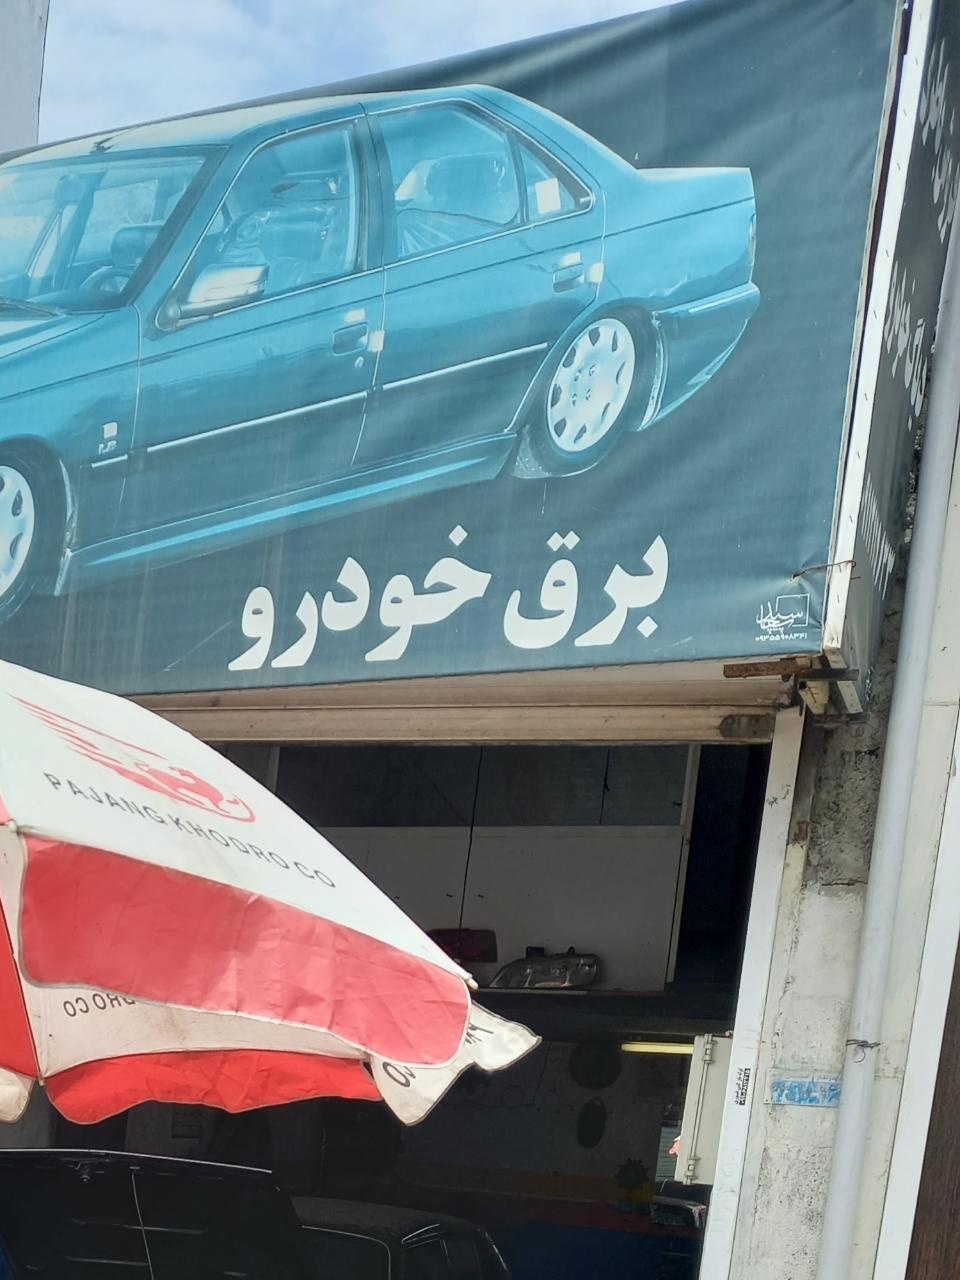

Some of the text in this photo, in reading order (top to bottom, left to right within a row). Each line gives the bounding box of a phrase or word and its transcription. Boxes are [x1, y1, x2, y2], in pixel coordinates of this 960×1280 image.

[883, 260, 916, 380] خودرو
[227, 523, 670, 672] برق خودرو
[43, 771, 336, 888] PAJANG KHODRO CO
